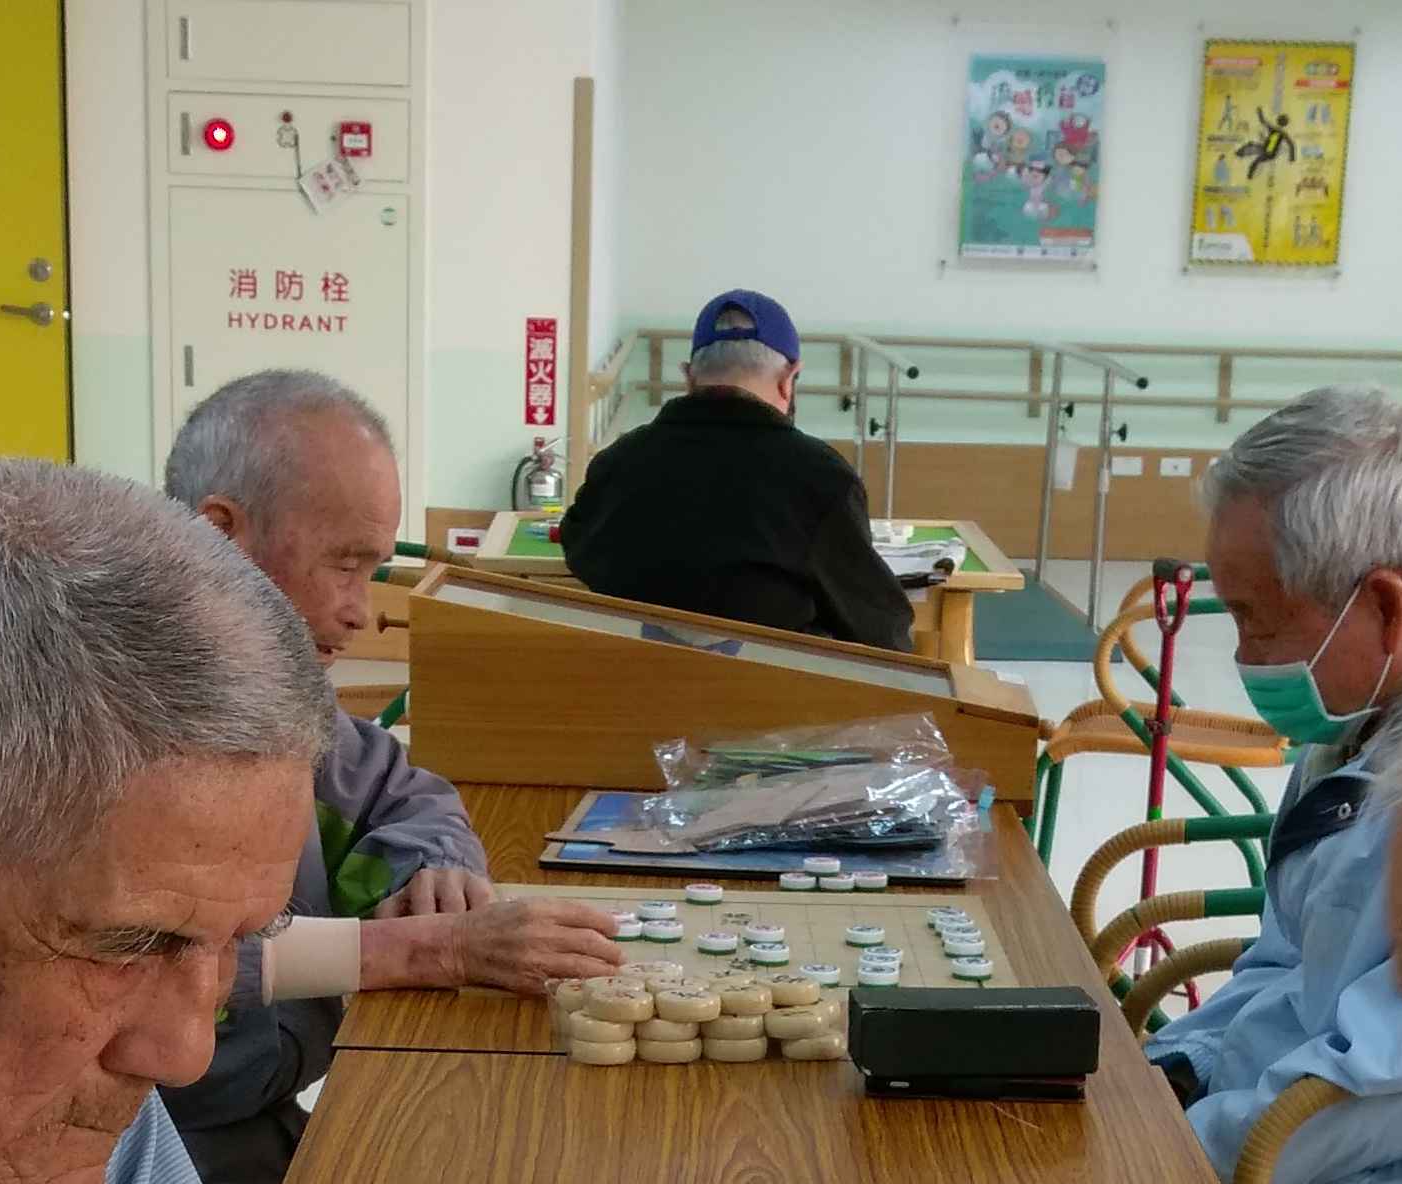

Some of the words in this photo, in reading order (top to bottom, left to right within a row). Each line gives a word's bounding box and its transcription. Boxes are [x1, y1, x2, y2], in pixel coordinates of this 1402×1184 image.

[229, 268, 350, 302] 消防栓
[228, 312, 349, 332] HYDRANT
[528, 337, 555, 407] 滅火器
